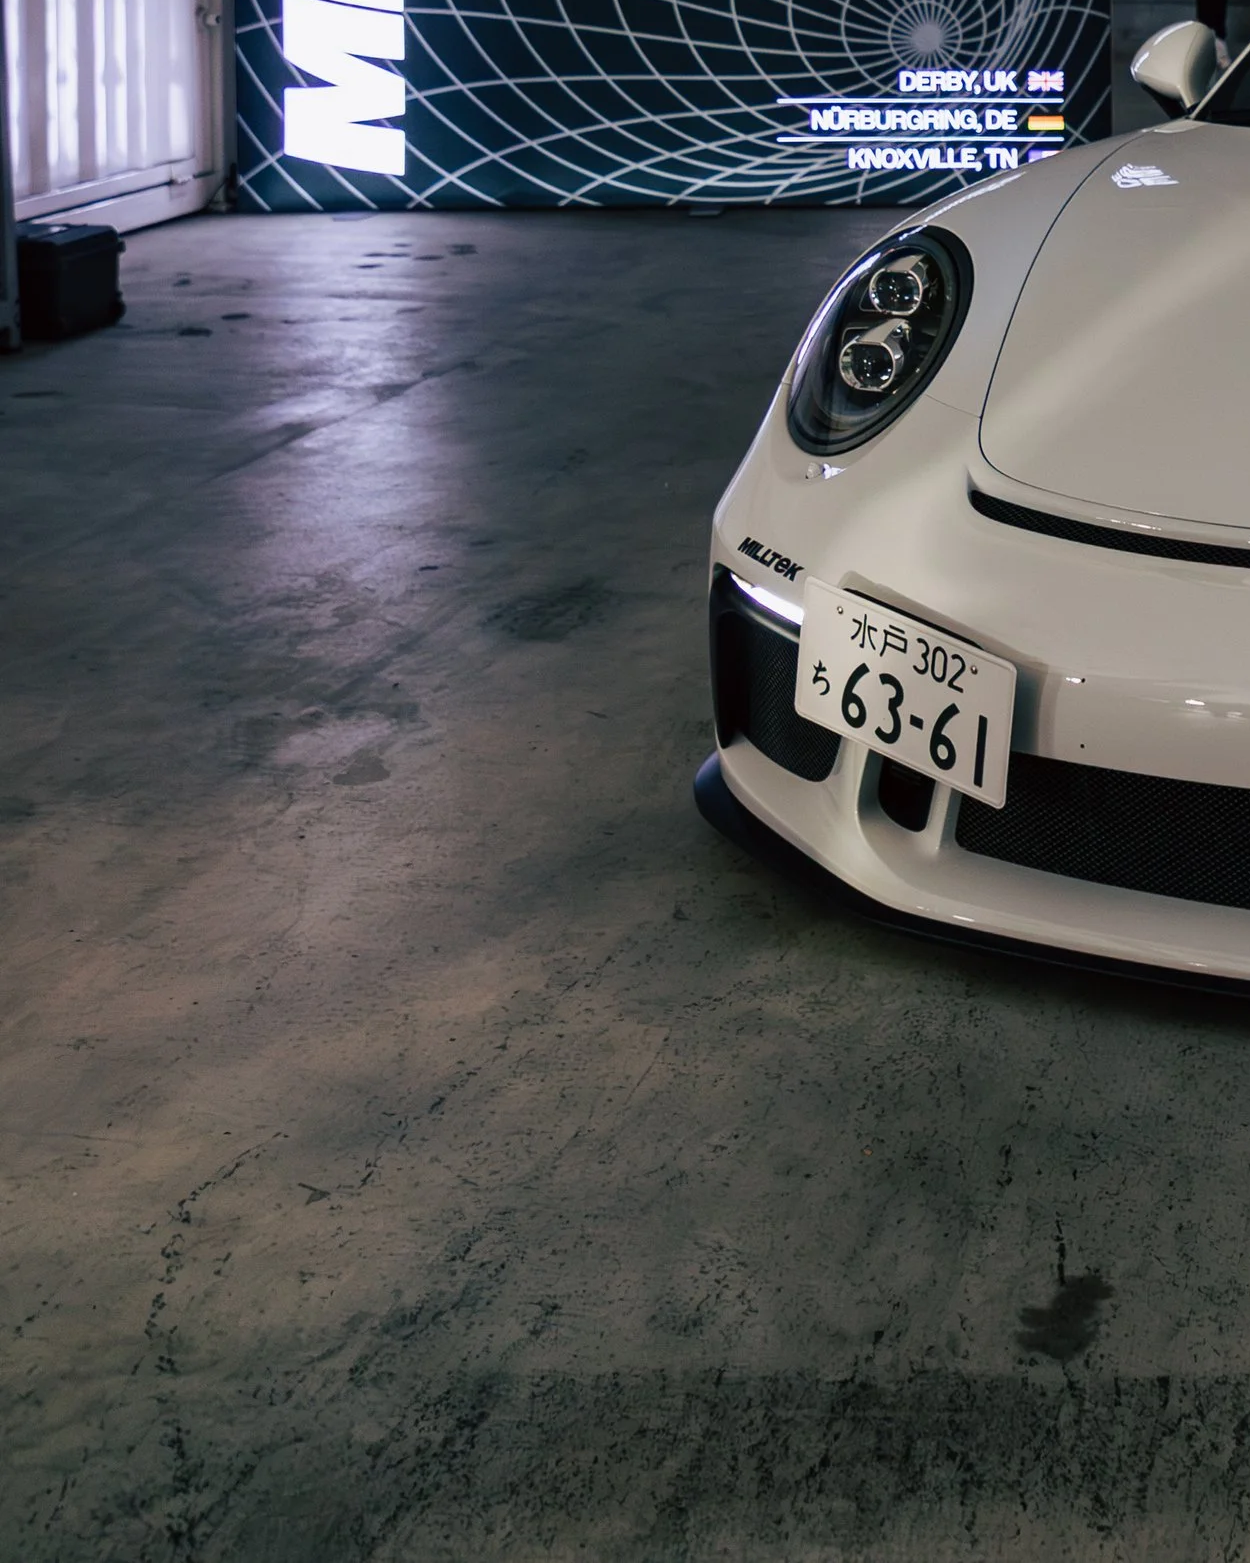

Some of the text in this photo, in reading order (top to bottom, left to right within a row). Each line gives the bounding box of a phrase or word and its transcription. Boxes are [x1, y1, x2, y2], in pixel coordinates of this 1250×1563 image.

[899, 70, 1018, 95] DERBY, UK
[810, 105, 1018, 134] NÜRBURGRING, DE
[848, 147, 1018, 172] KNOXVILLE, TN
[850, 613, 966, 694] 水戸 302
[811, 659, 988, 788] ち 63-61
